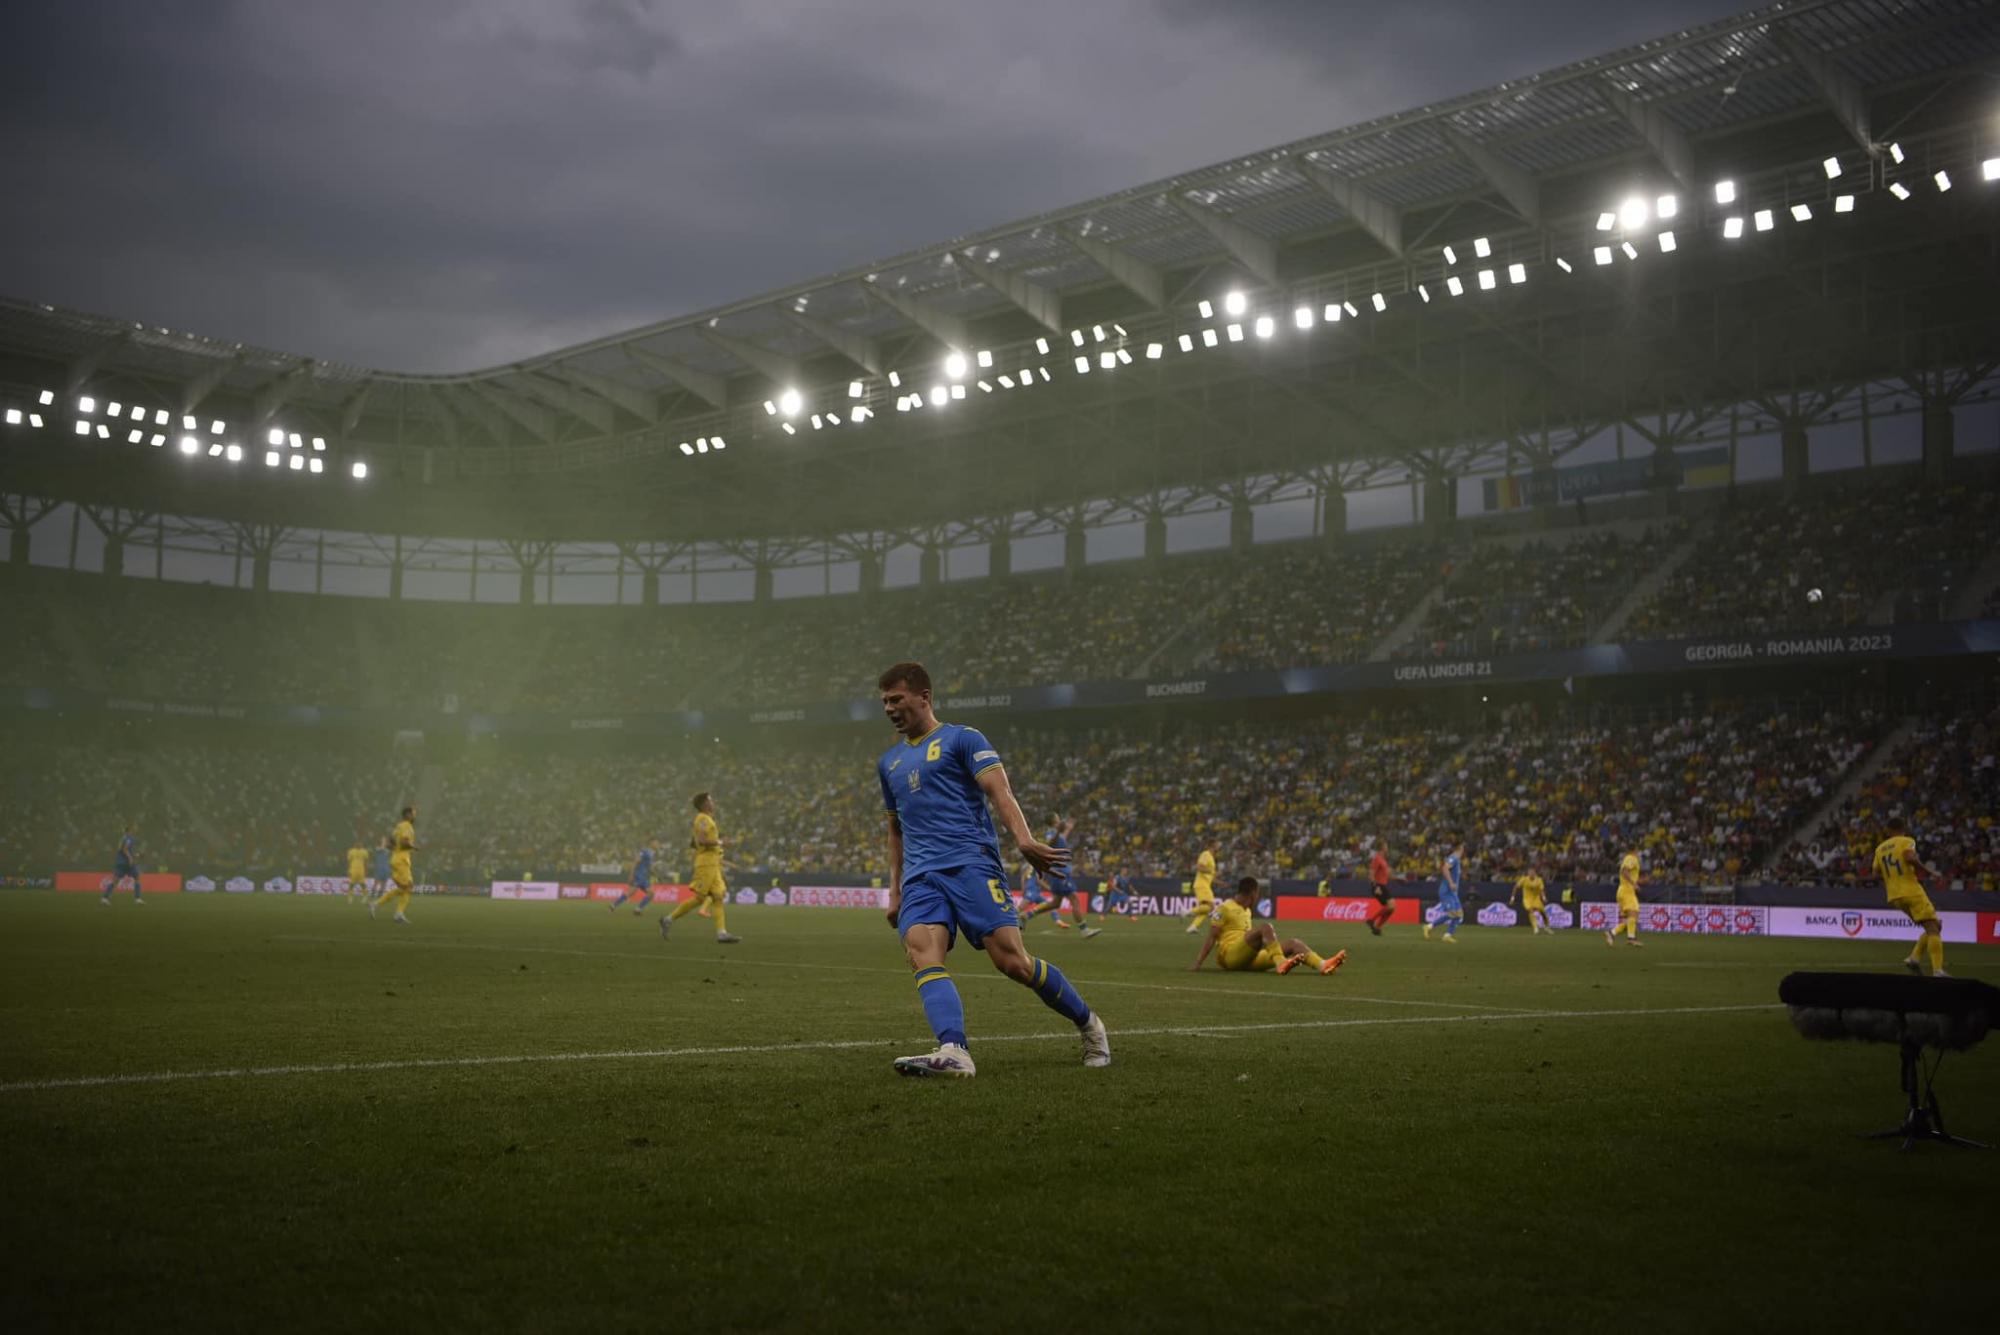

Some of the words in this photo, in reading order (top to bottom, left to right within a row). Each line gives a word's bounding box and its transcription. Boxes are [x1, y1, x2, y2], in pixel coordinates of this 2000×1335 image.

[1686, 642, 1753, 661] GEORGIA
[1767, 637, 1845, 656] ROMANIA
[1849, 635, 1892, 651] 2023
[1394, 664, 1428, 681] UEFA
[1429, 661, 1475, 679] UNDER
[1477, 660, 1492, 676] 21
[1146, 680, 1207, 697] BUCHAREST
[926, 738, 942, 762] 6
[1881, 852, 1904, 878] 14
[987, 878, 1006, 904] 6
[1116, 896, 1159, 915] UEFA
[1805, 915, 1838, 926] BANCA
